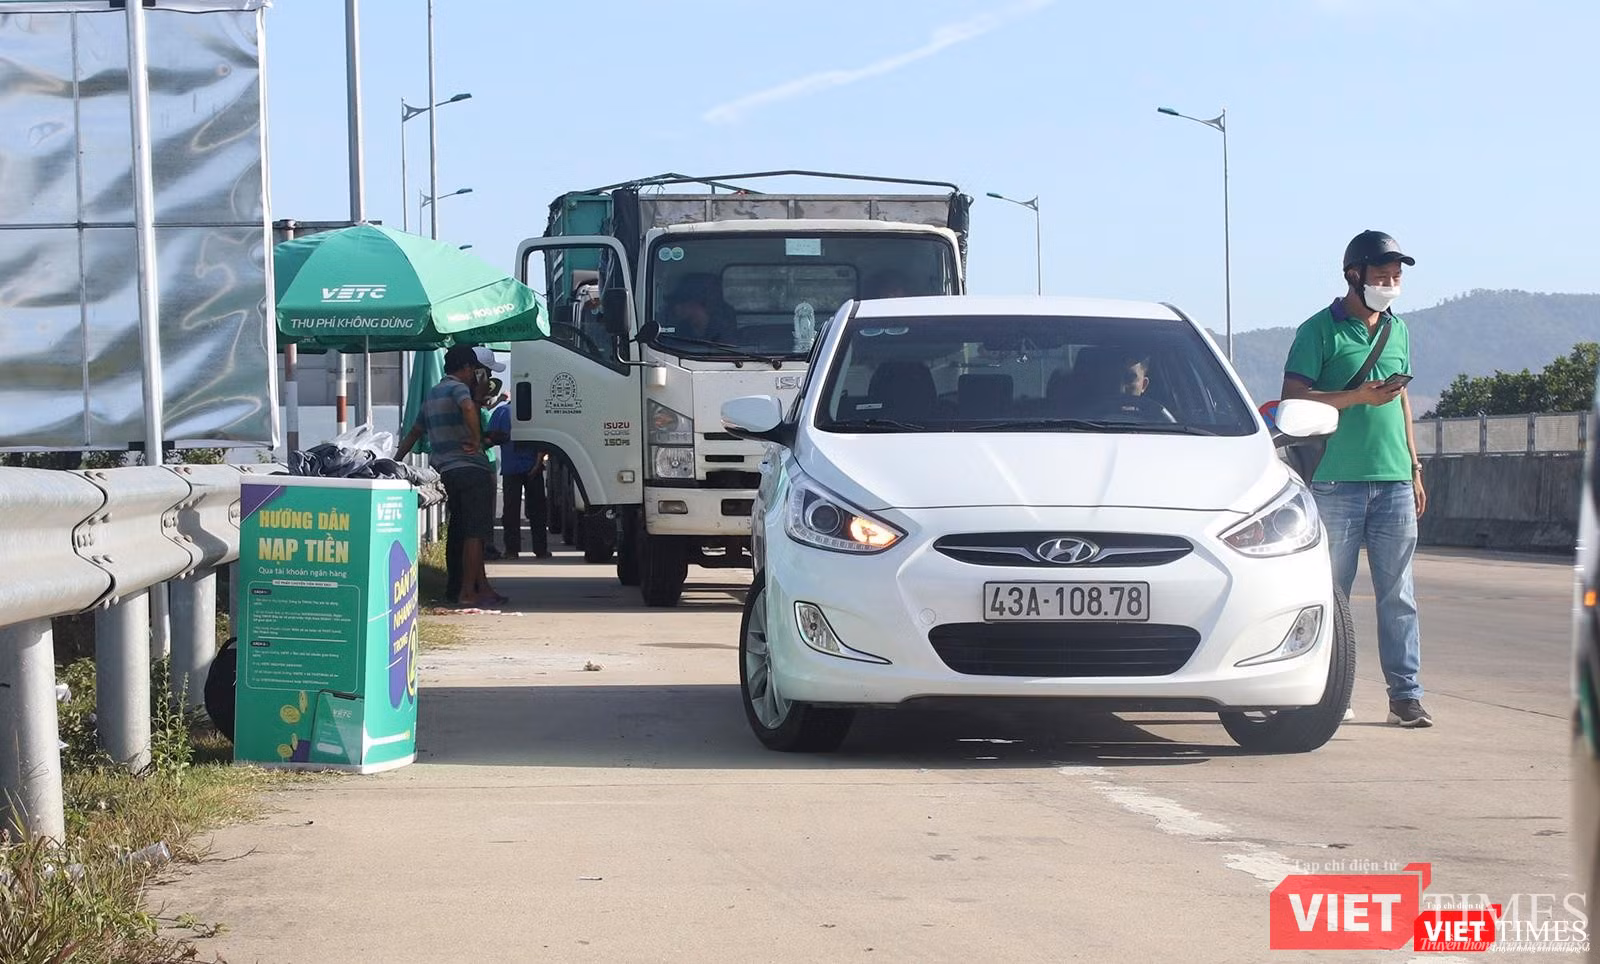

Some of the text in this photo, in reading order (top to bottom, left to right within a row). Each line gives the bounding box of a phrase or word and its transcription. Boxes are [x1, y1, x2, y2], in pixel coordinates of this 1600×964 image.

[321, 286, 387, 301] VETC
[291, 315, 414, 328] THU PHÍ KHÔNG DỪNG
[259, 507, 350, 531] HƯỚNG DẪN
[258, 533, 349, 564] NẠP TIỀN
[259, 566, 273, 576] Qua
[990, 586, 1142, 616] 43A-108.78
